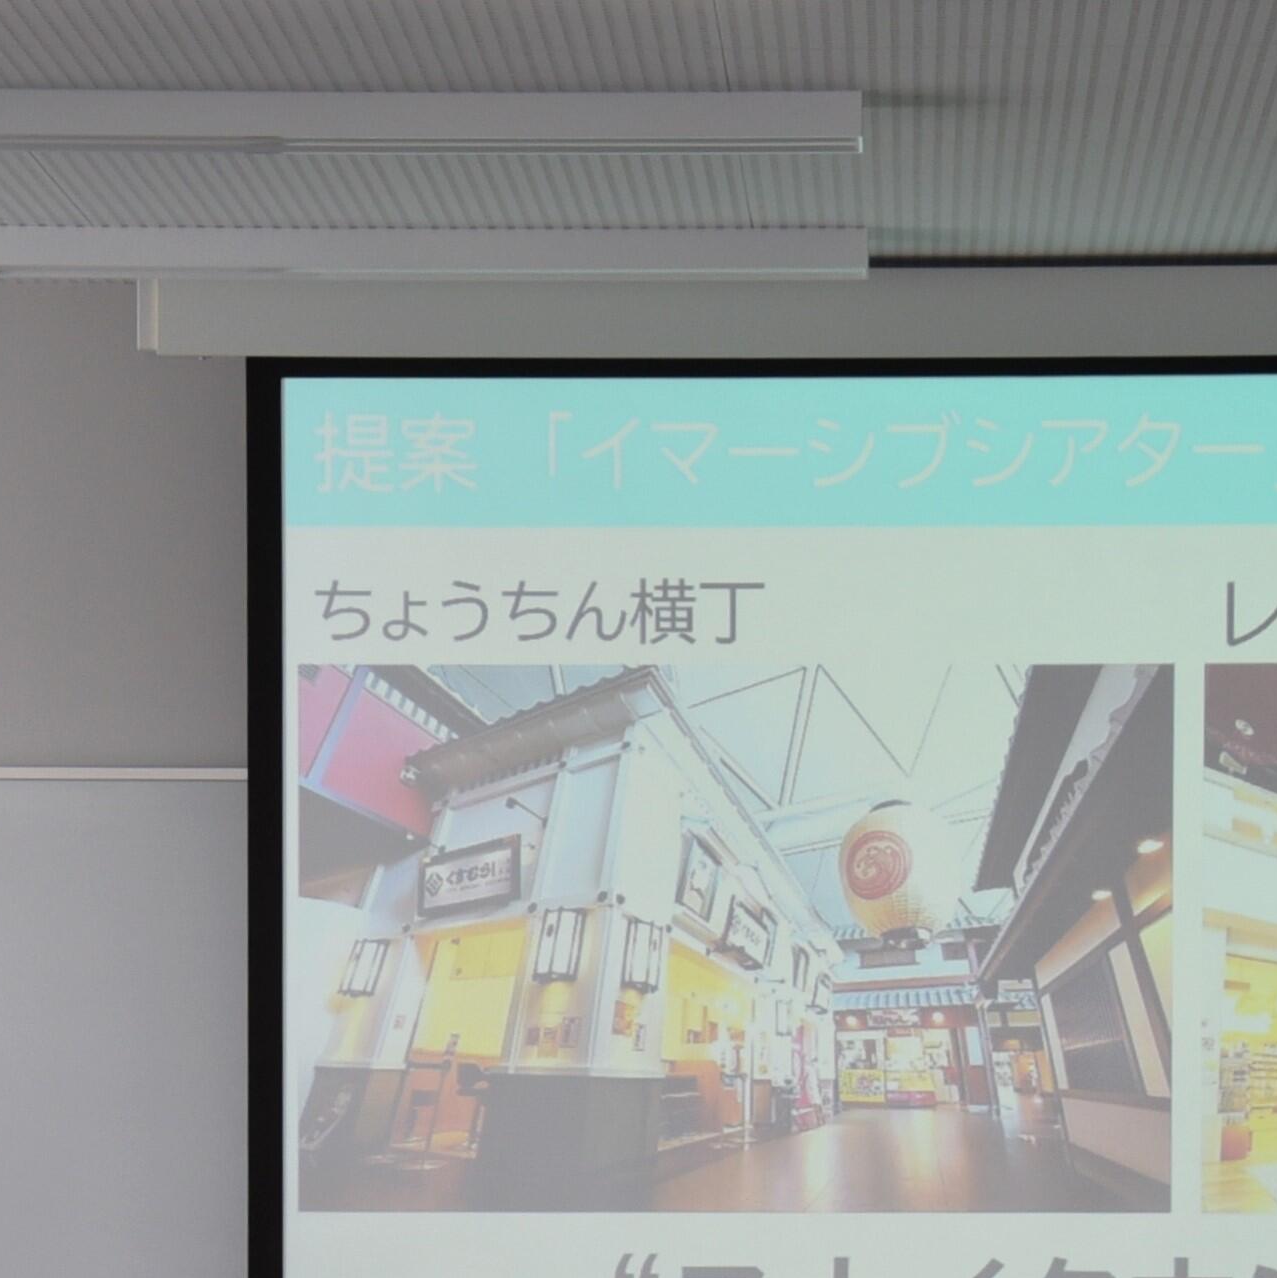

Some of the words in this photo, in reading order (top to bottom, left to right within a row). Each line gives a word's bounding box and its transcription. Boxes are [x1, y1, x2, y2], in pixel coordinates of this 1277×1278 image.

[315, 409, 477, 493] 提案
[314, 577, 766, 645] ちょうちん横丁
